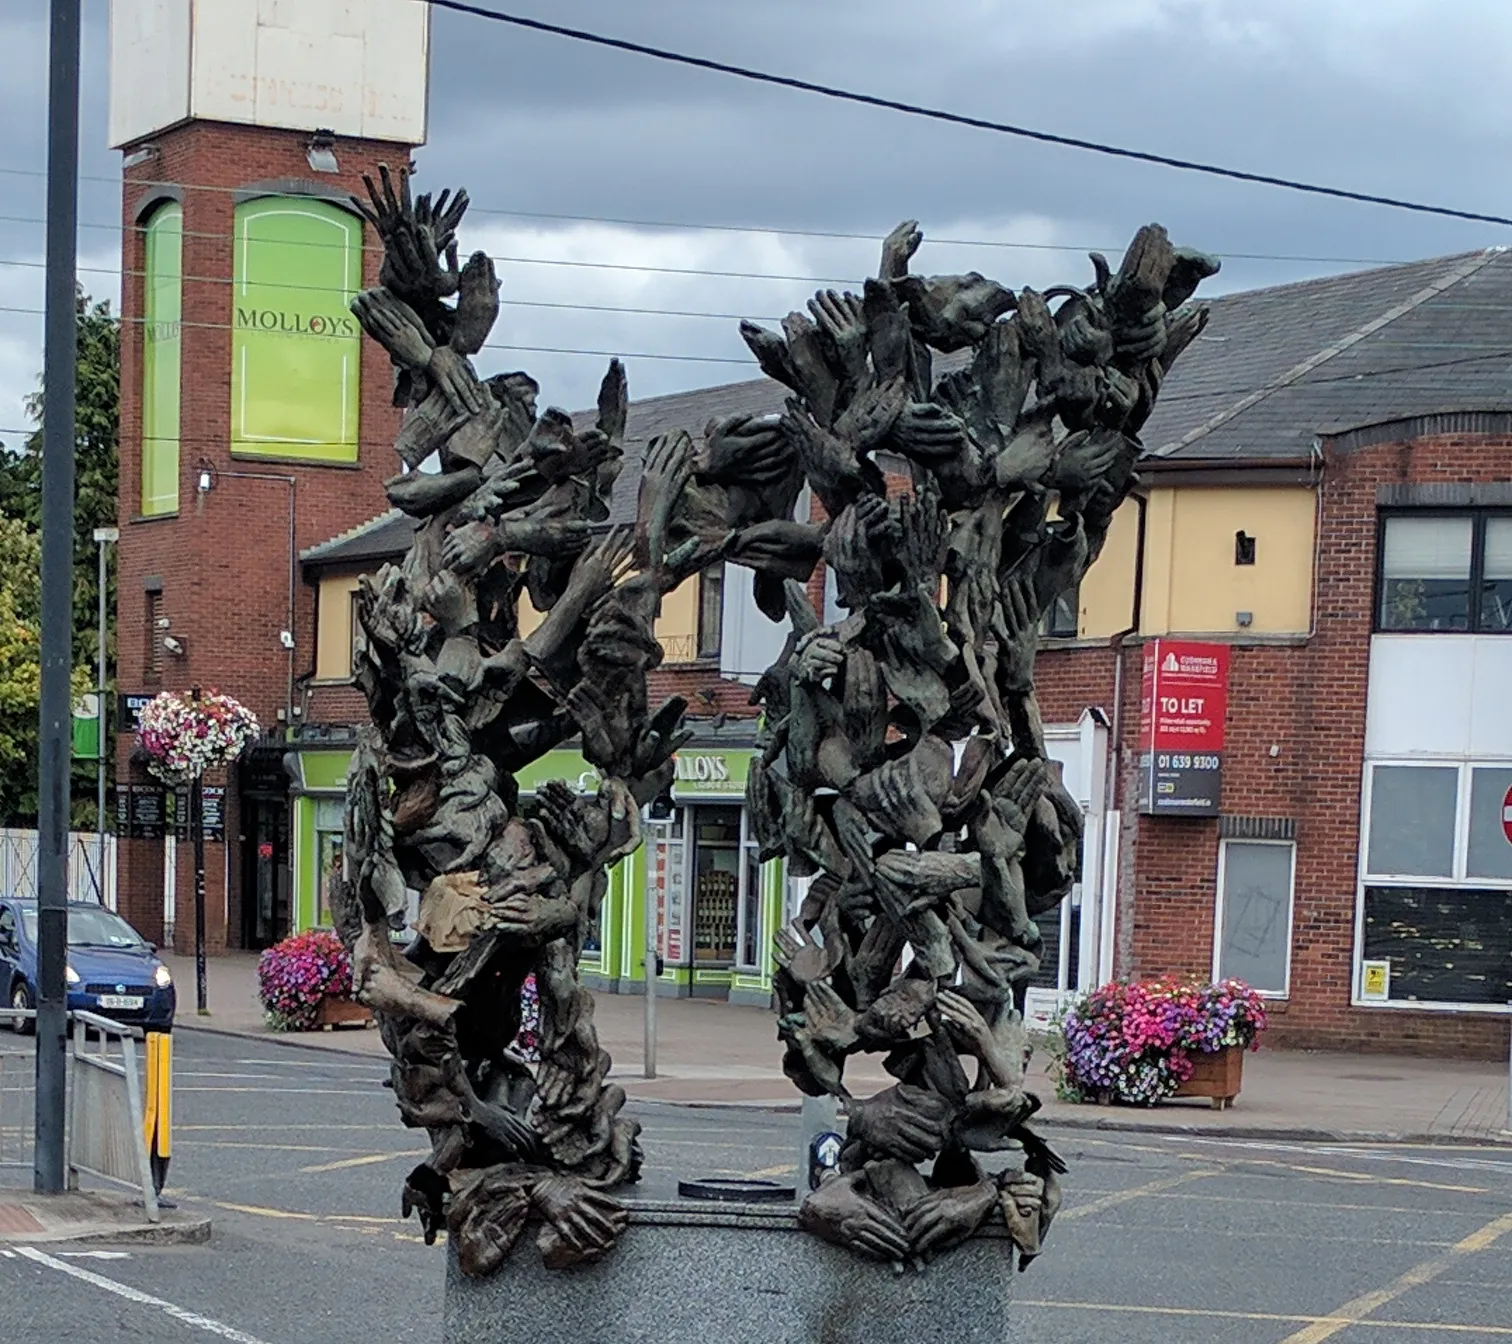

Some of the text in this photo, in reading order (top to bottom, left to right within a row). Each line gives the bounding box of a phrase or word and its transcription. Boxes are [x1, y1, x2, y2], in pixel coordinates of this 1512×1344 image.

[238, 308, 354, 335] MOLLOYS
[1160, 696, 1204, 714] TO LET
[673, 755, 728, 780] LLOYS
[1158, 754, 1170, 768] 01
[1172, 755, 1191, 769] 639
[1193, 755, 1219, 770] 9300
